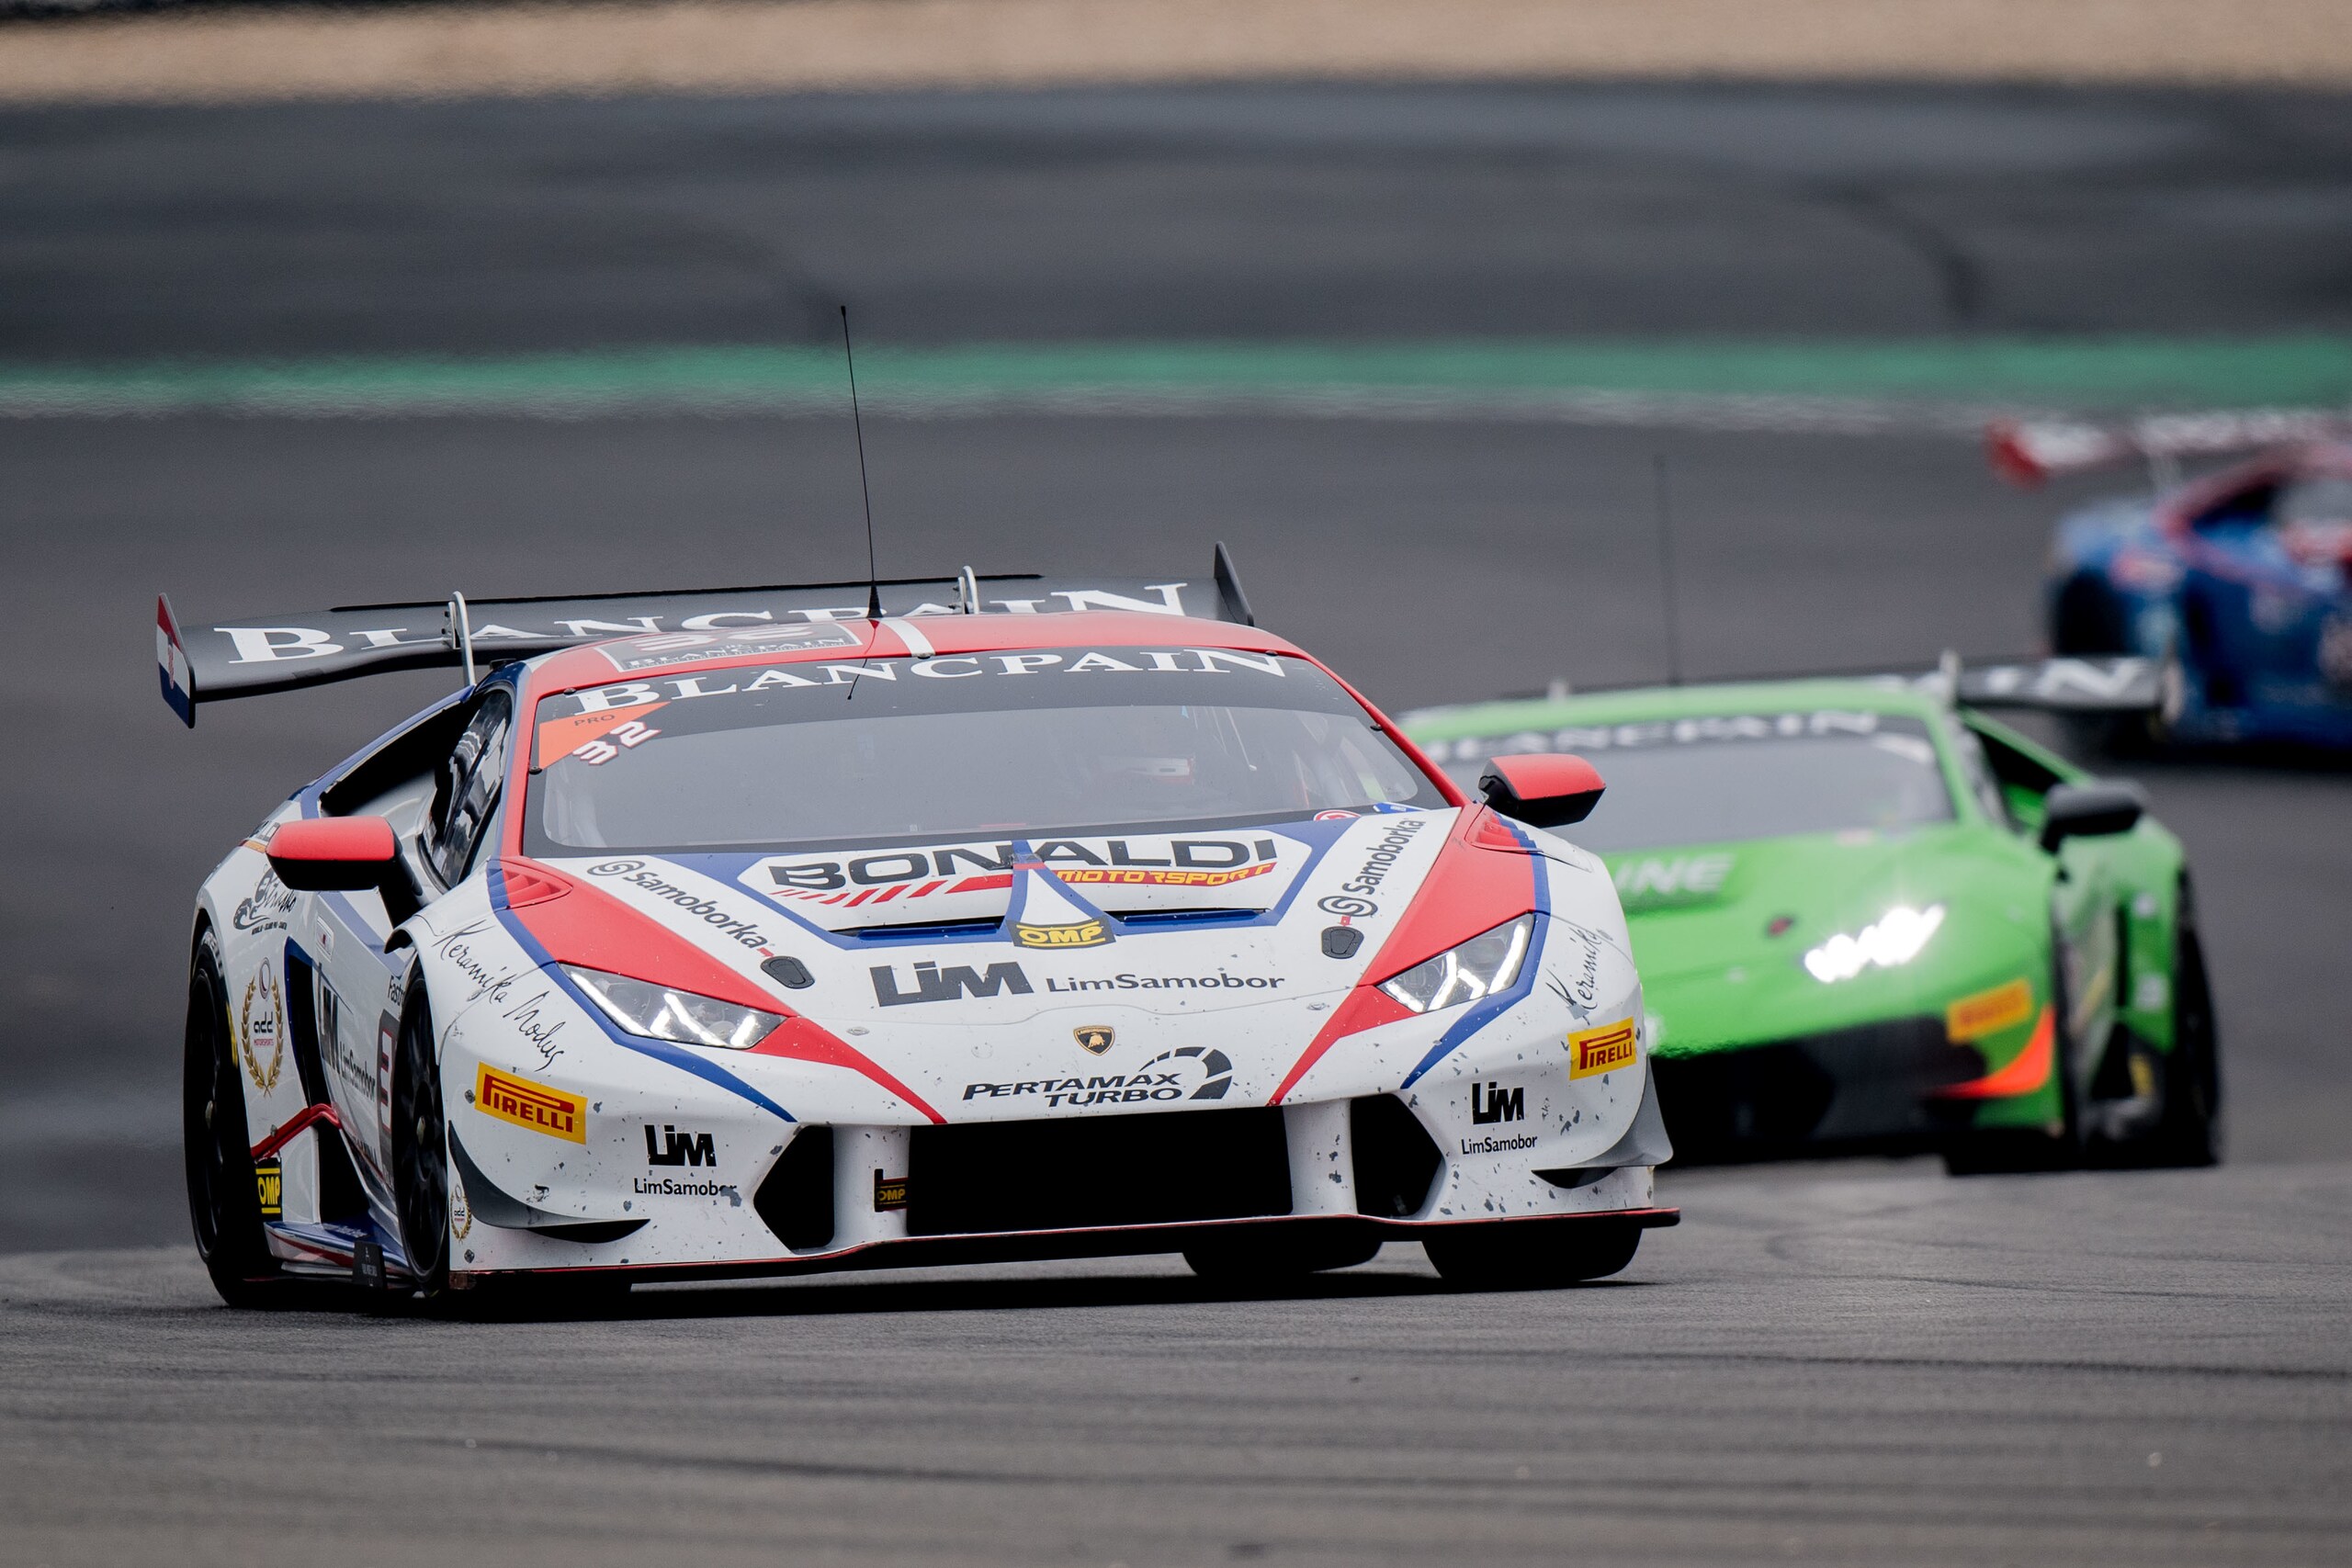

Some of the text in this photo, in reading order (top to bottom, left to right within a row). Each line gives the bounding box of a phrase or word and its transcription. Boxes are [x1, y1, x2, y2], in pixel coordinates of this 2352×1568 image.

[570, 649, 1286, 715] BLANCPAIN
[573, 713, 616, 727] PRO
[571, 719, 664, 766] 32
[767, 839, 1278, 890] BONALDI
[1341, 818, 1427, 895] Samoborka
[1057, 863, 1275, 886] MOTORSPORT
[624, 871, 768, 949] Samoborka
[1018, 925, 1104, 944] OMP
[1046, 973, 1285, 993] LimSamobor
[1579, 1027, 1632, 1070] PIRELLI
[962, 1072, 1182, 1100] PERTAMAX
[1044, 1087, 1182, 1108] TURBO
[482, 1073, 576, 1134] PIRELLI
[1461, 1134, 1538, 1155] LimSamobor
[258, 1176, 281, 1205] OMP
[876, 1188, 906, 1201] OMP
